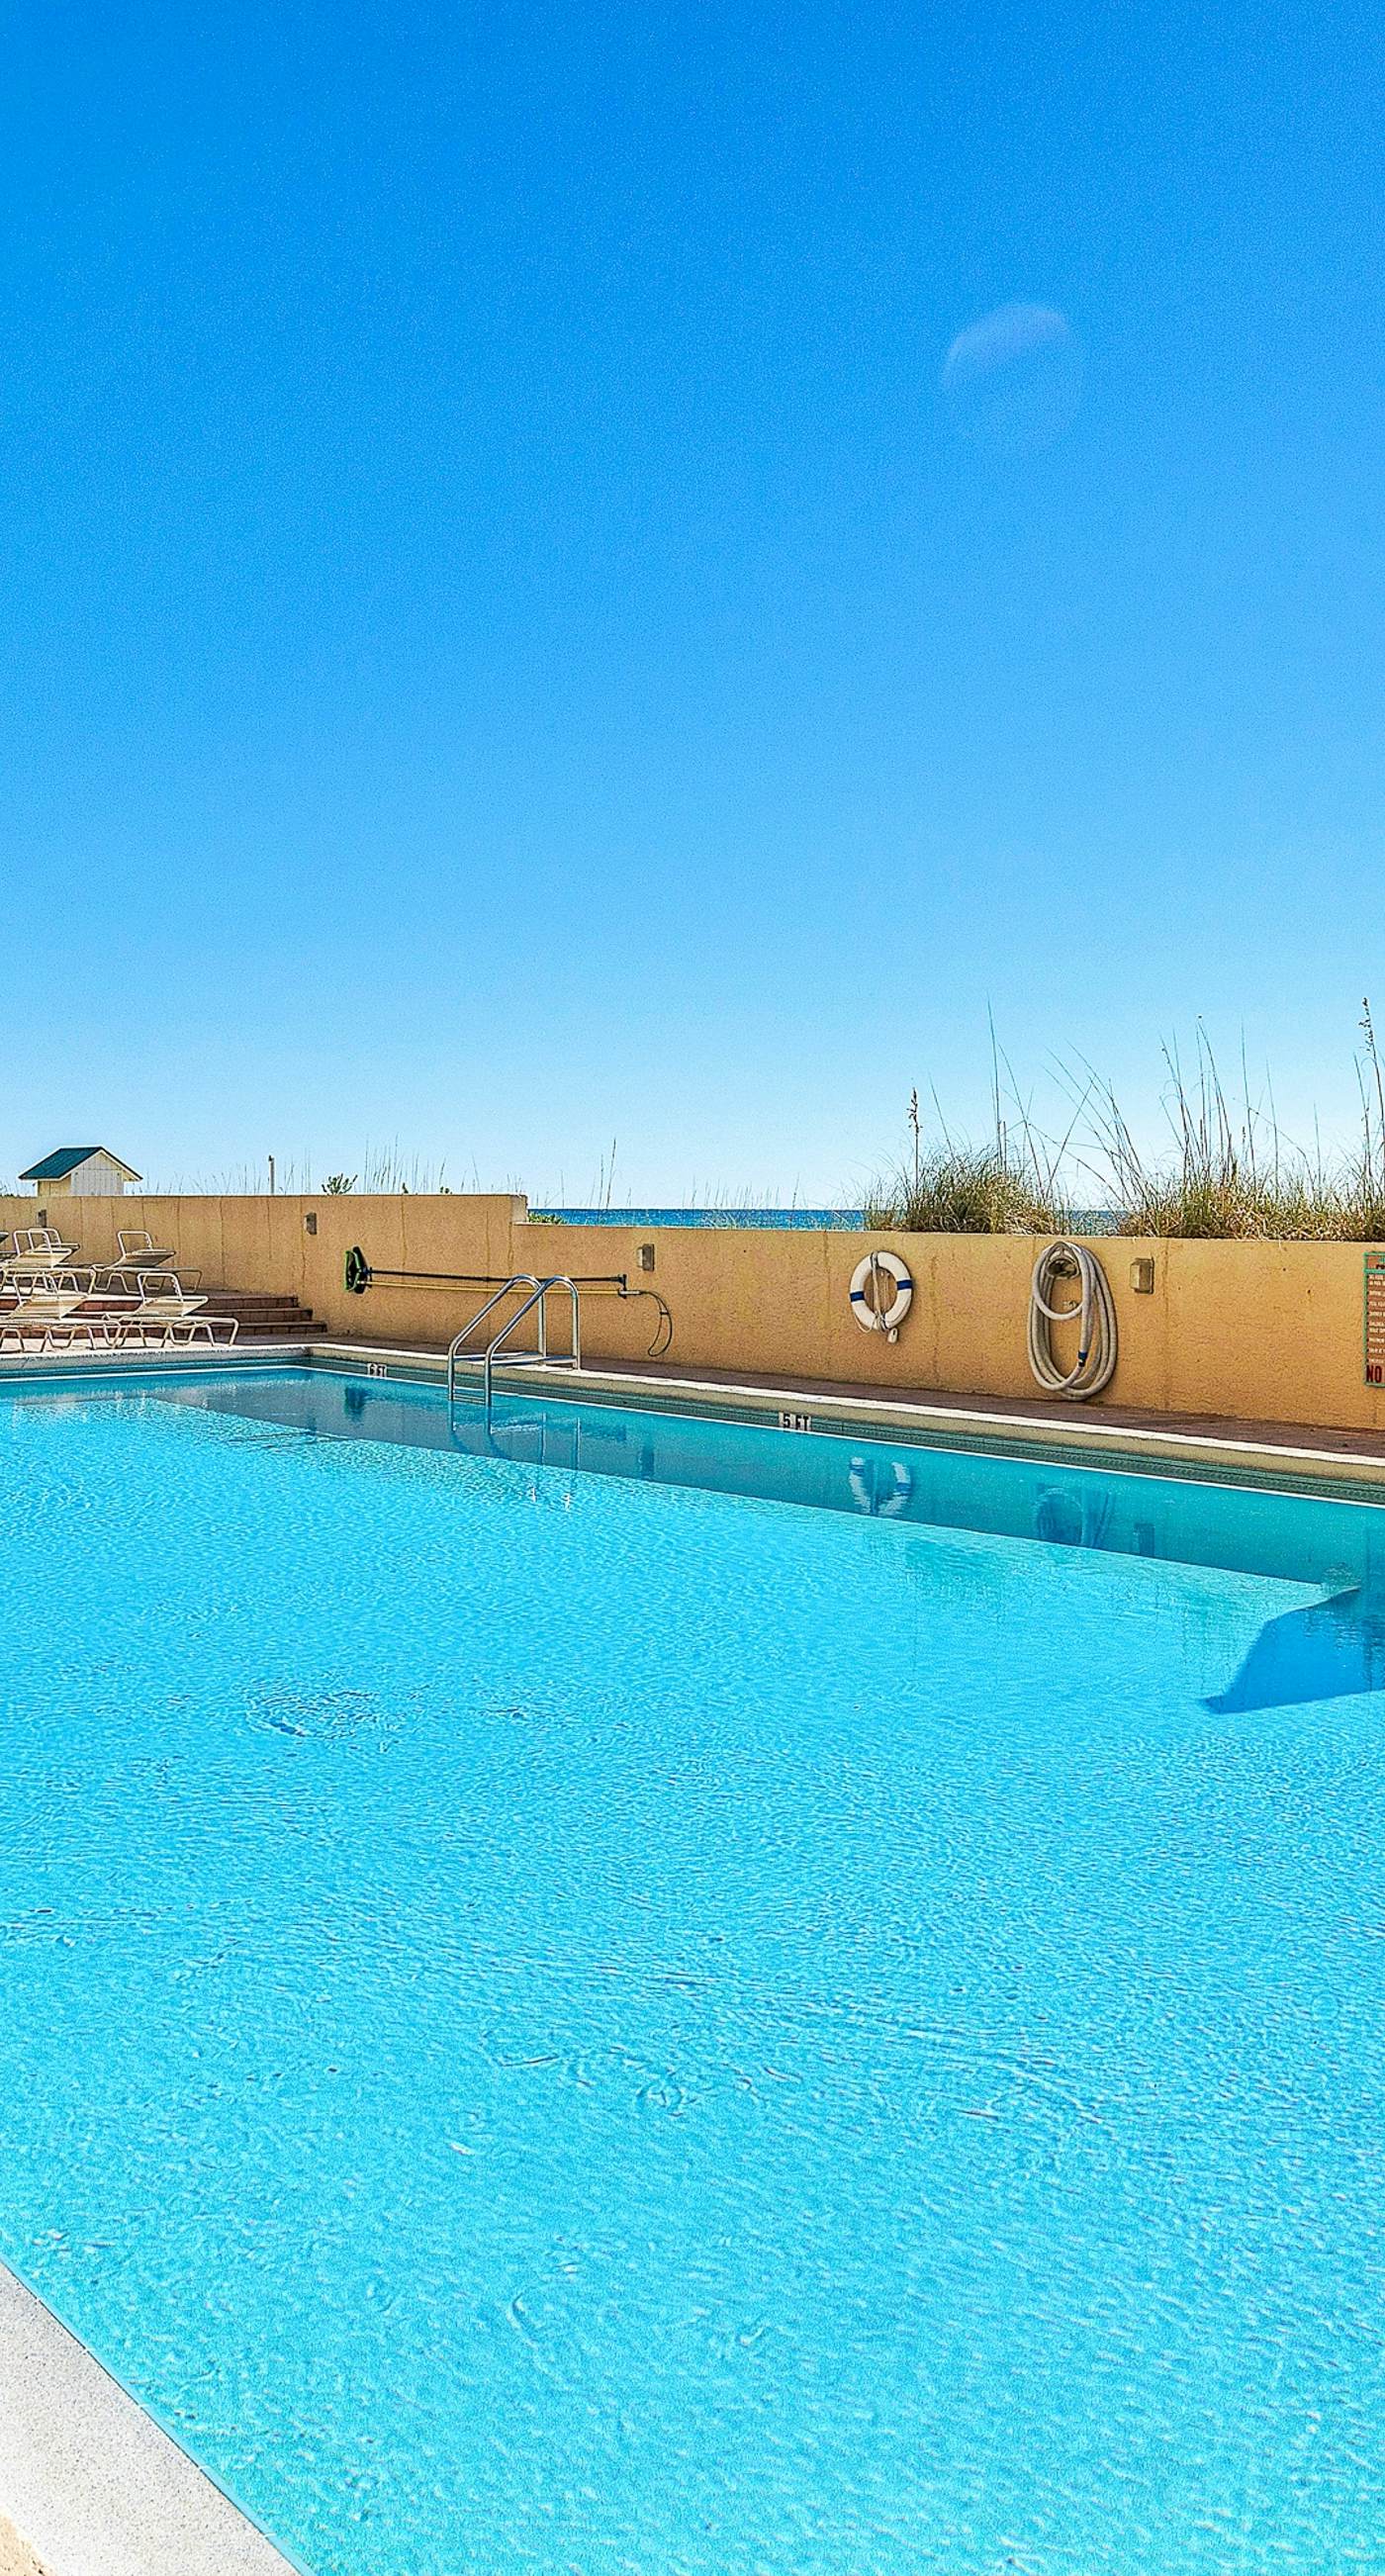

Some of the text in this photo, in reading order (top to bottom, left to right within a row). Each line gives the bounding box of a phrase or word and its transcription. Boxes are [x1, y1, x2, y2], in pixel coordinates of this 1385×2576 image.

[1366, 1364, 1382, 1383] NO
[783, 1413, 808, 1430] 5 FT
